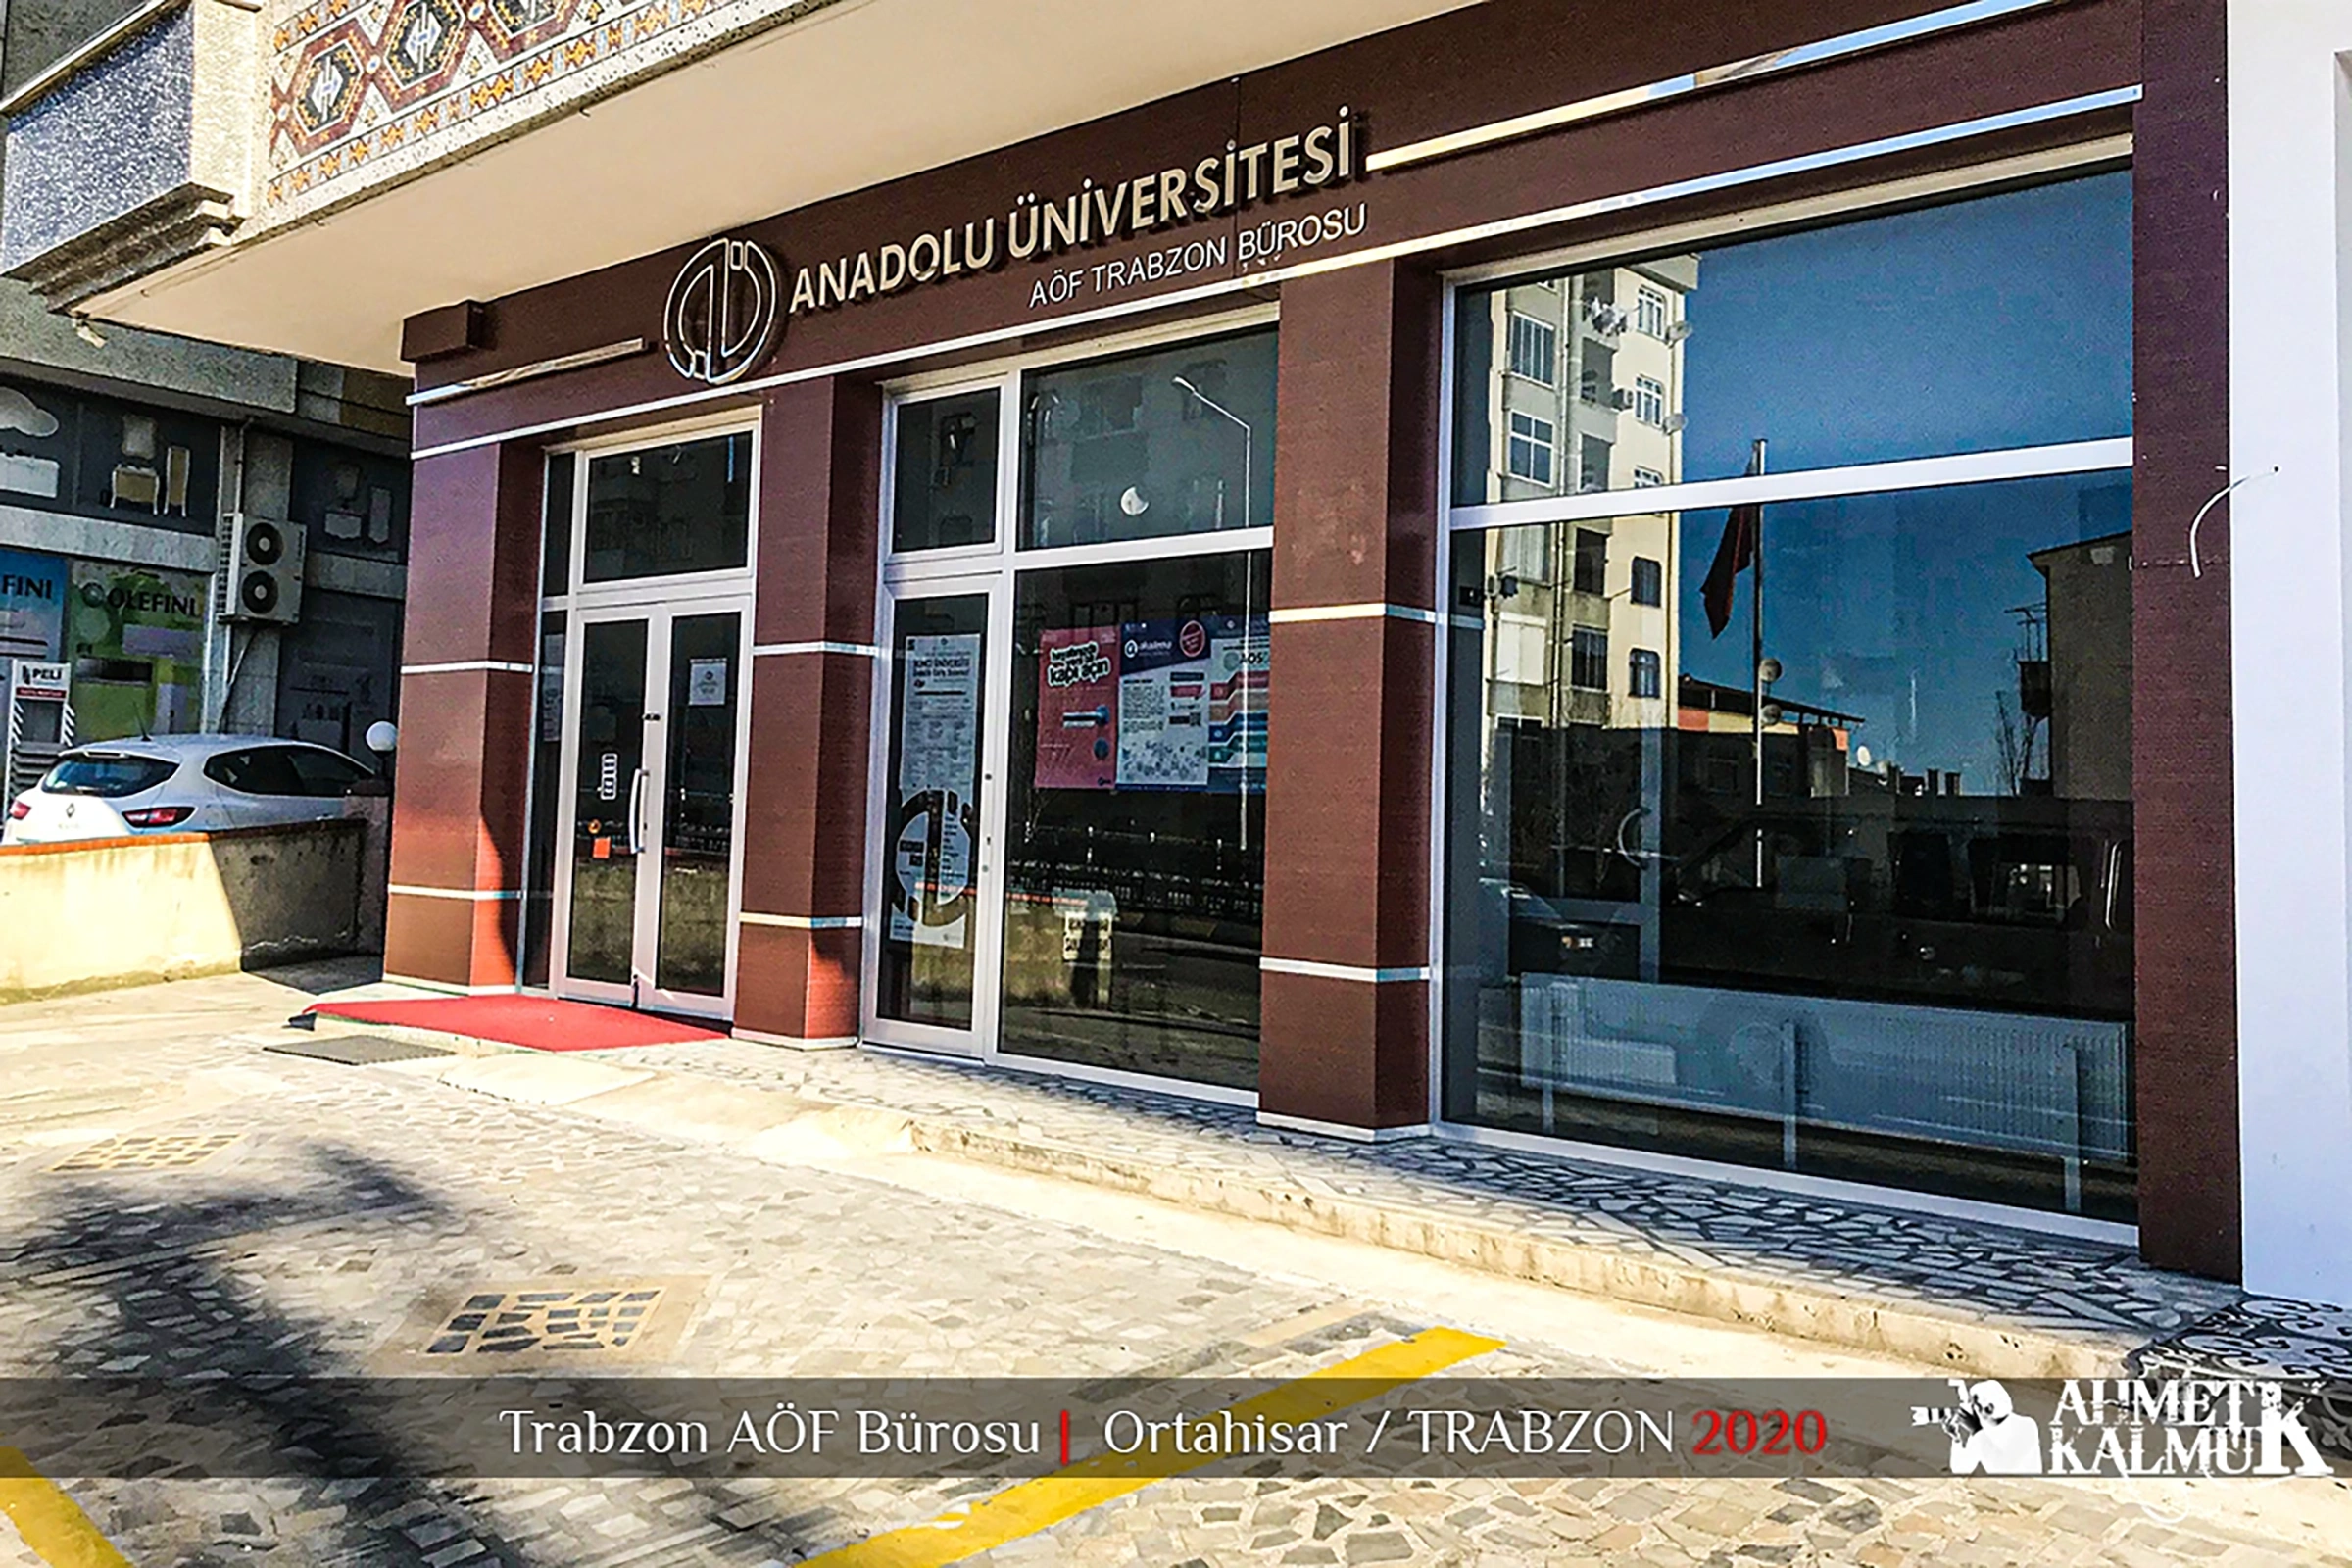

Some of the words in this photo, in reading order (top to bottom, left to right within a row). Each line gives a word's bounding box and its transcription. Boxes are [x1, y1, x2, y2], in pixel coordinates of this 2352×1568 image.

[789, 218, 995, 313] ANADOLU
[1008, 106, 1350, 259] ÜNİVERSİTESİ
[1029, 269, 1083, 308] AÖF
[1091, 236, 1227, 293] TRABZON
[1238, 203, 1367, 261] BÜROSU
